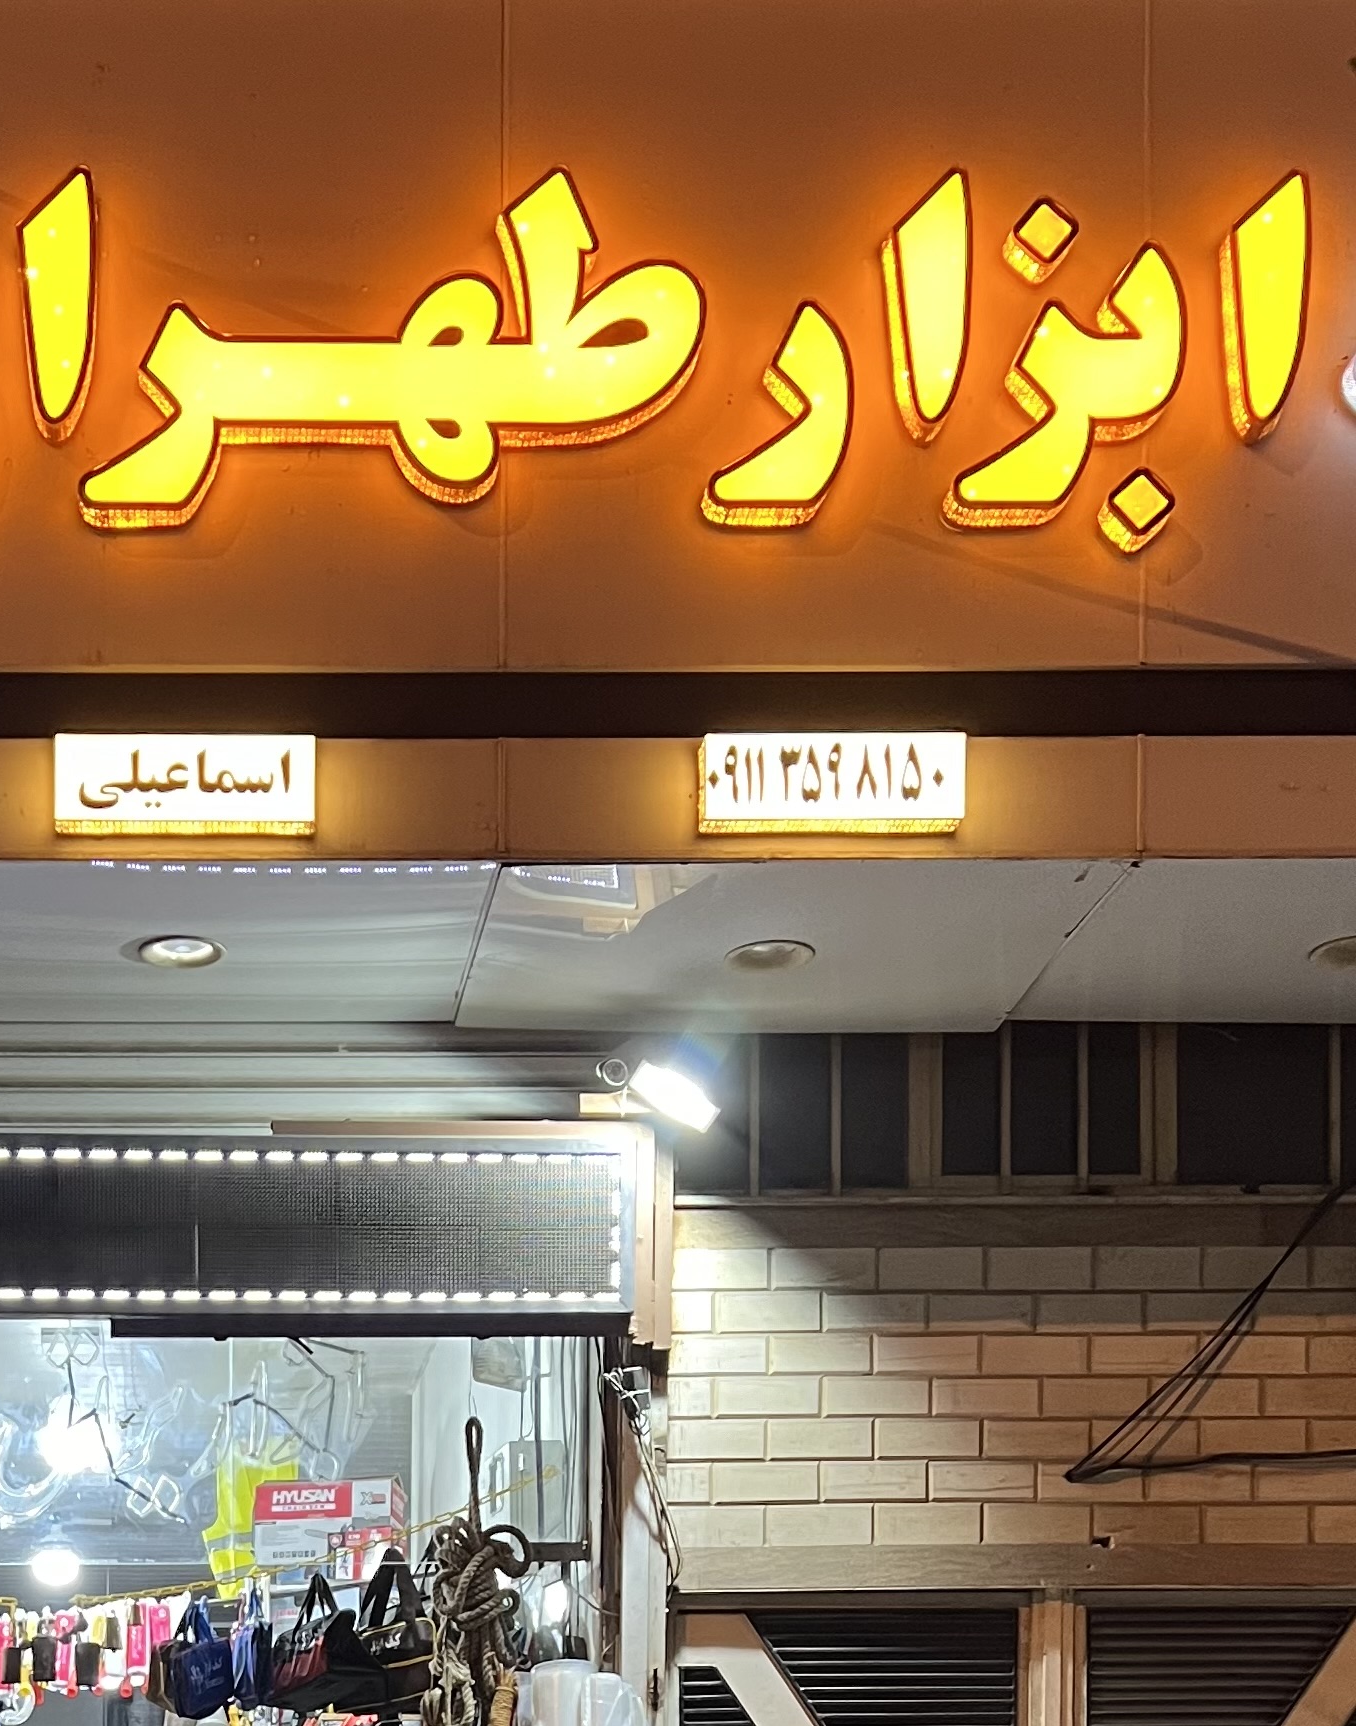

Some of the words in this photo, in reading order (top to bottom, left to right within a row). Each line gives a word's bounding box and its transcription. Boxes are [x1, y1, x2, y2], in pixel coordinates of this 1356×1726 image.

[700, 163, 1313, 557] ابزار
[78, 747, 291, 809] اسماعیلی
[271, 1488, 337, 1505] HYUSAN
